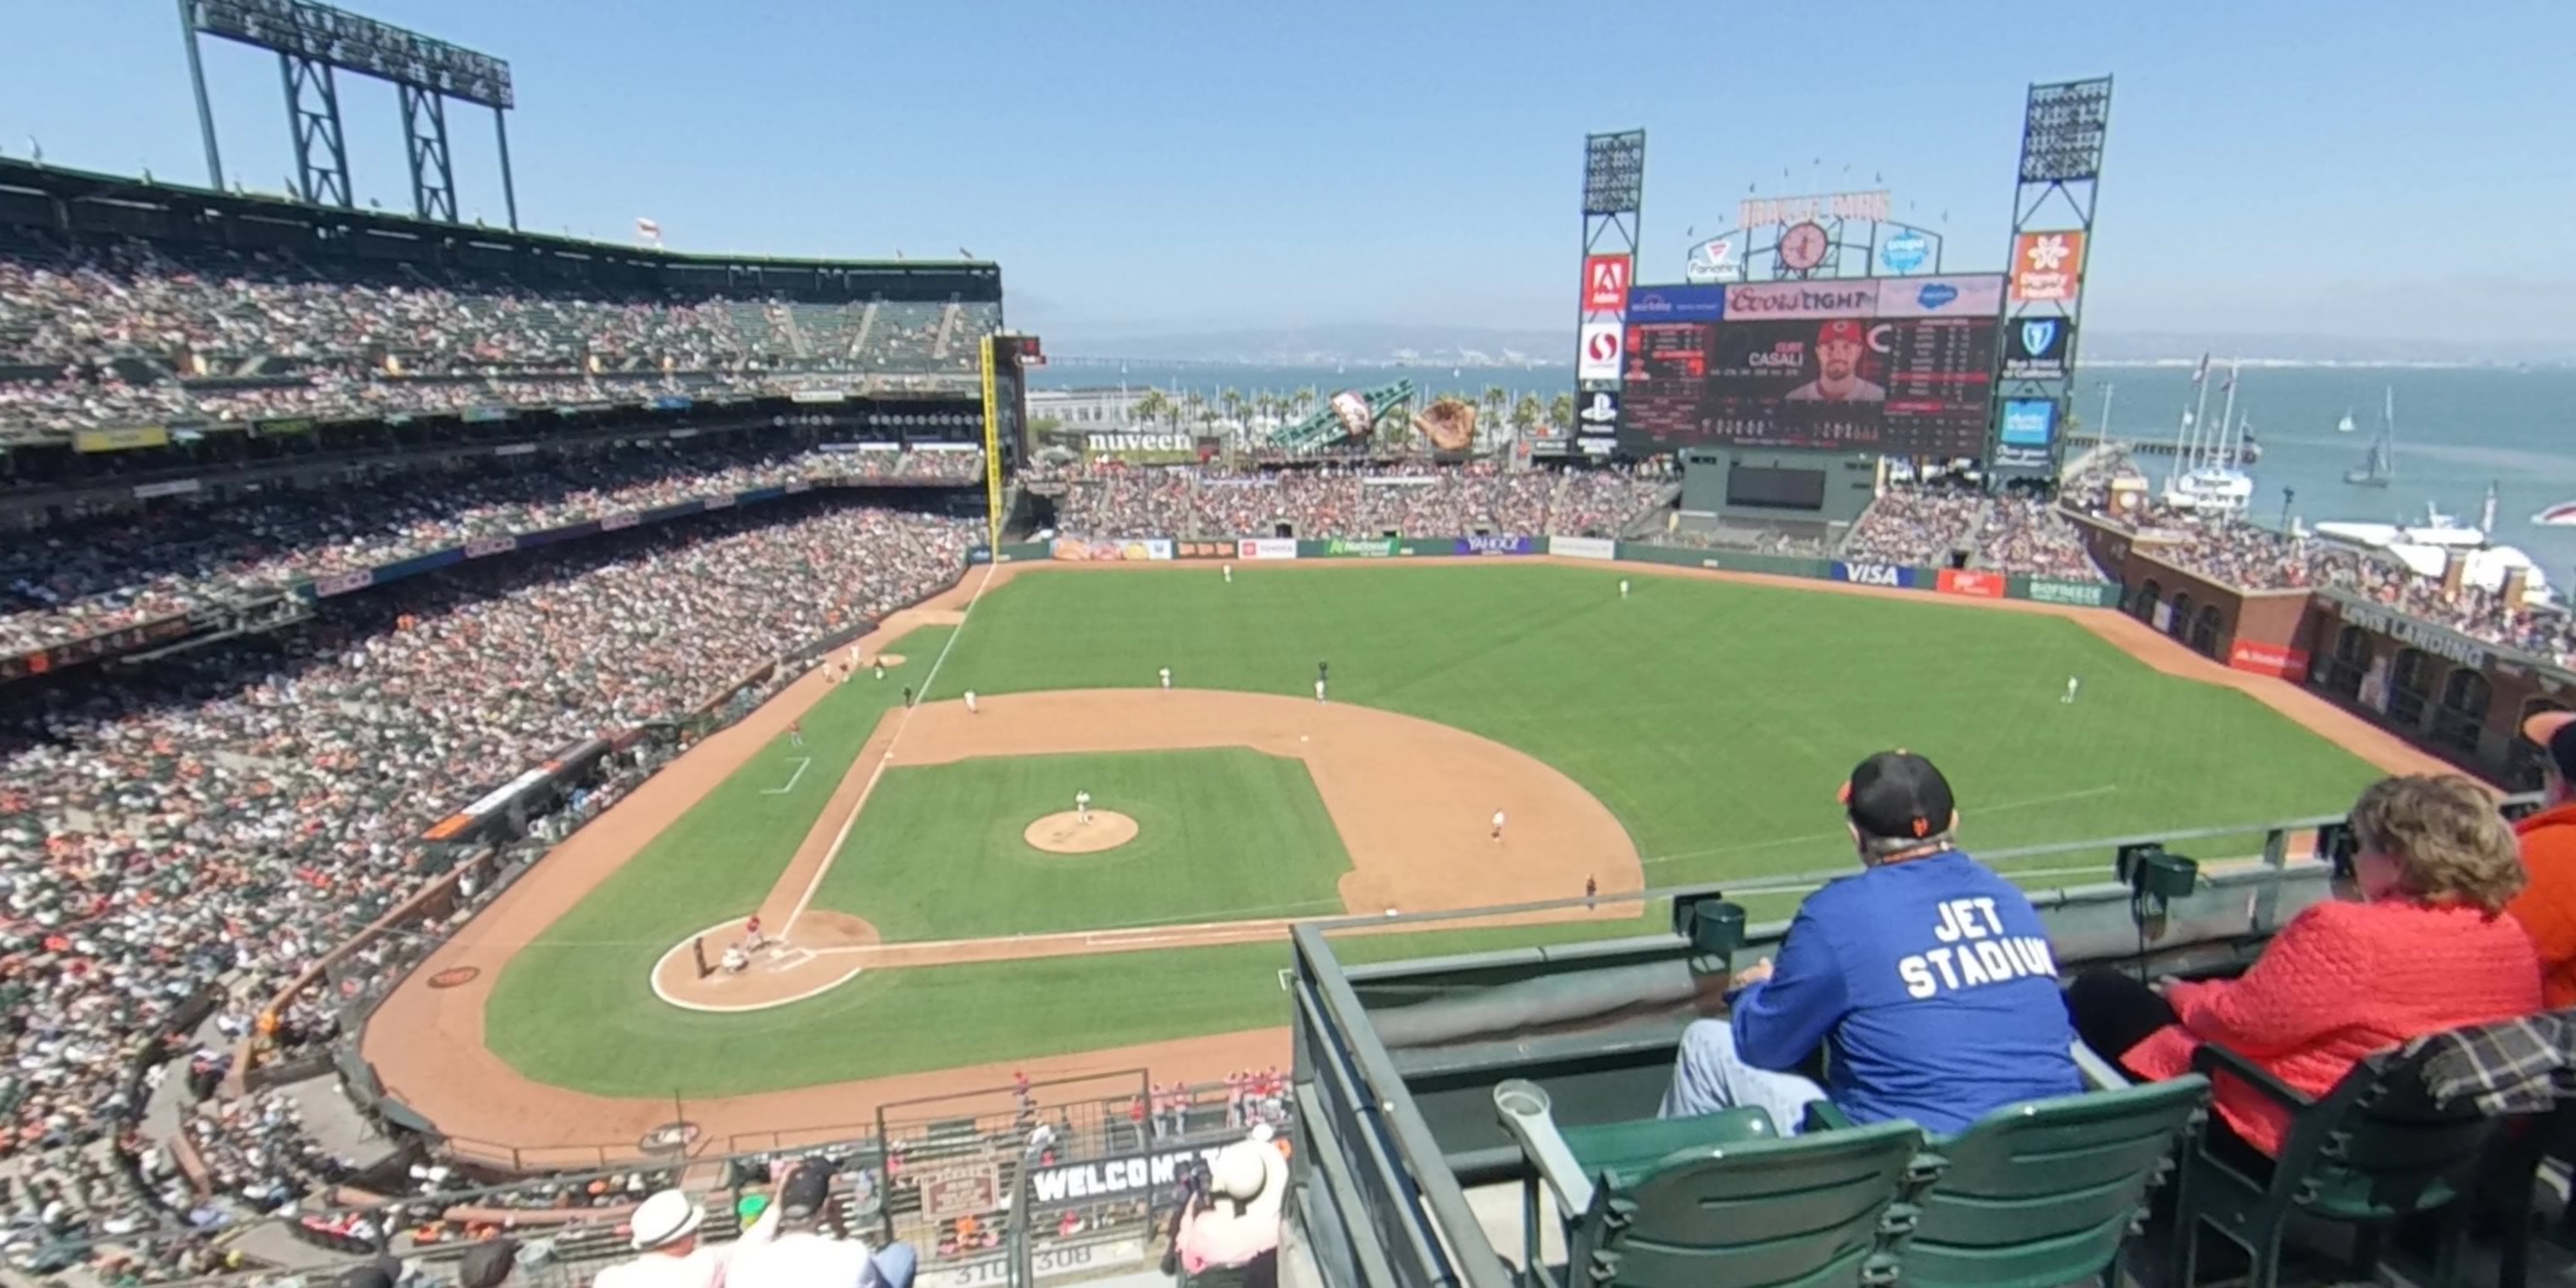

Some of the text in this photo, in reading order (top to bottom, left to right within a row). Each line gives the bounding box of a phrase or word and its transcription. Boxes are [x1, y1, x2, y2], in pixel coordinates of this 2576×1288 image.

[1730, 287, 1871, 312] Coors LIGHT
[1749, 352, 1803, 366] CASALI
[1088, 434, 1192, 451] nuveen
[1845, 563, 1898, 586] VISA
[2390, 619, 2484, 669] LANDING
[1935, 897, 2003, 942] JET
[1036, 1246, 1092, 1270] 308
